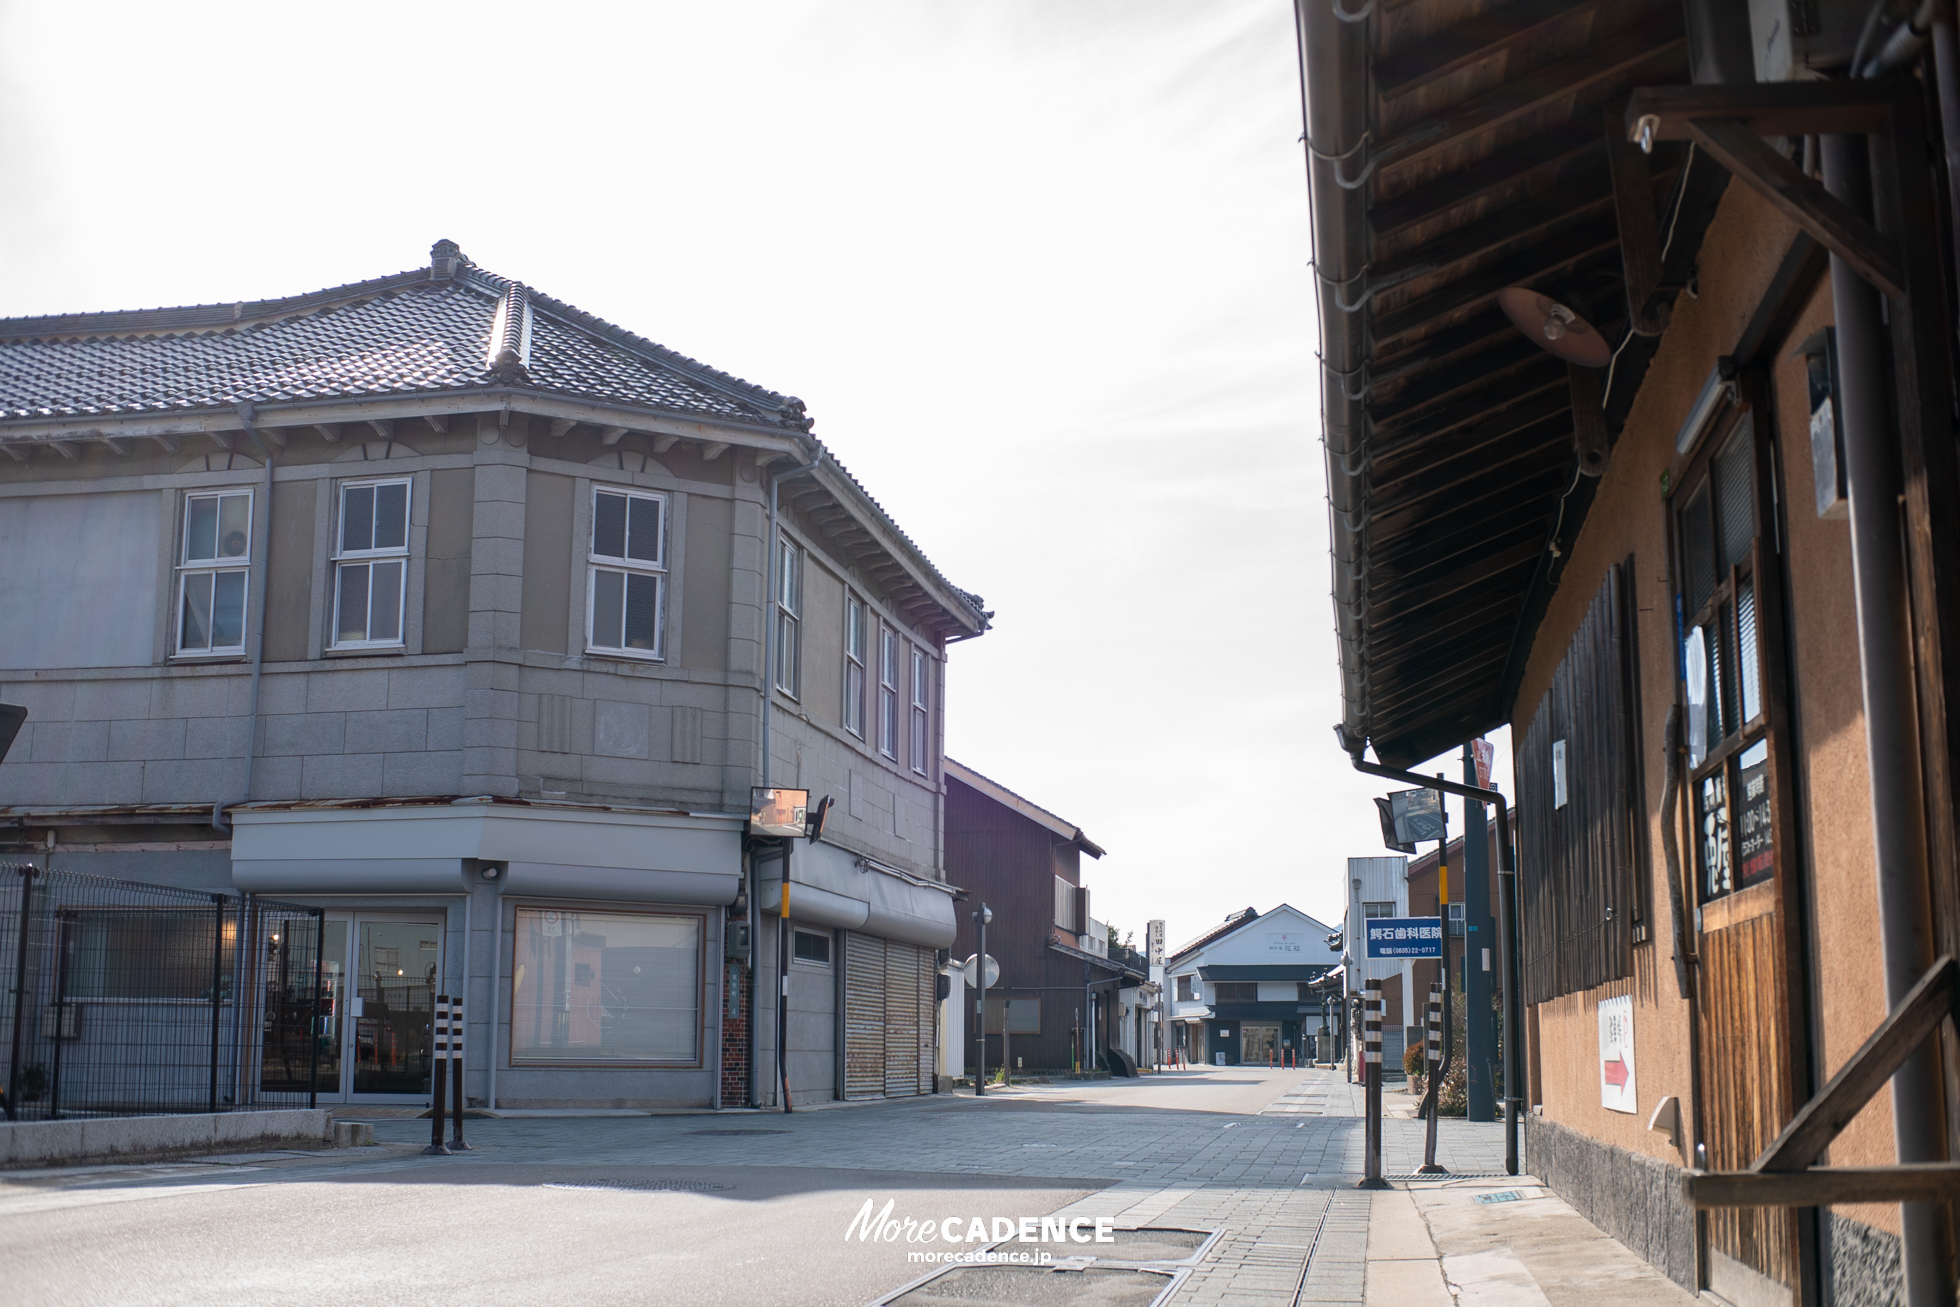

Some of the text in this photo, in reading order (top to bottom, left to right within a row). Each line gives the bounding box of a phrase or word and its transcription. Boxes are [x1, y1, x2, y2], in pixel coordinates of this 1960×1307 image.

[1370, 926, 1442, 940] 鰐石歯科医院
[1155, 938, 1163, 966] 田中屋
